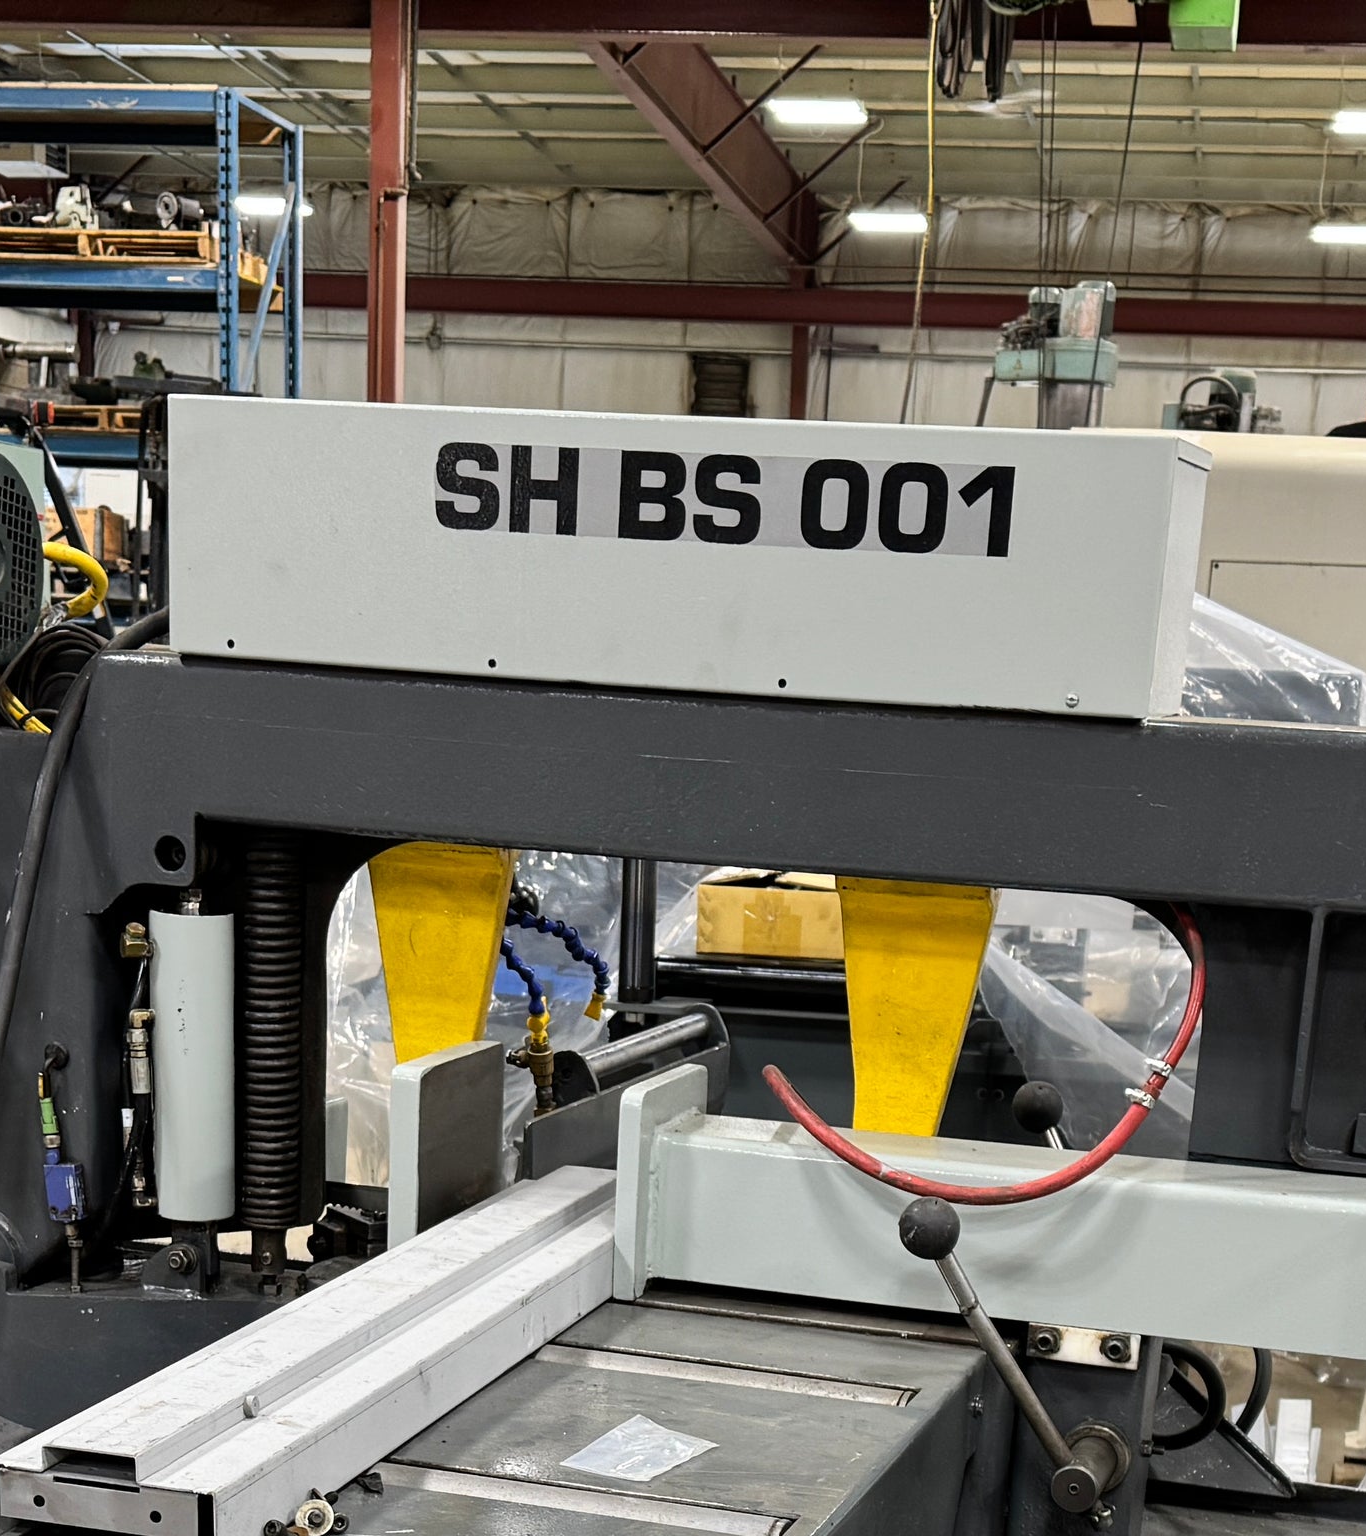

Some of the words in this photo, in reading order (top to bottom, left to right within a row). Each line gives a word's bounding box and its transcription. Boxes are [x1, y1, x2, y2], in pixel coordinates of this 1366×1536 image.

[435, 441, 579, 536] SH
[618, 449, 762, 545] BS
[800, 458, 1016, 558] 001
